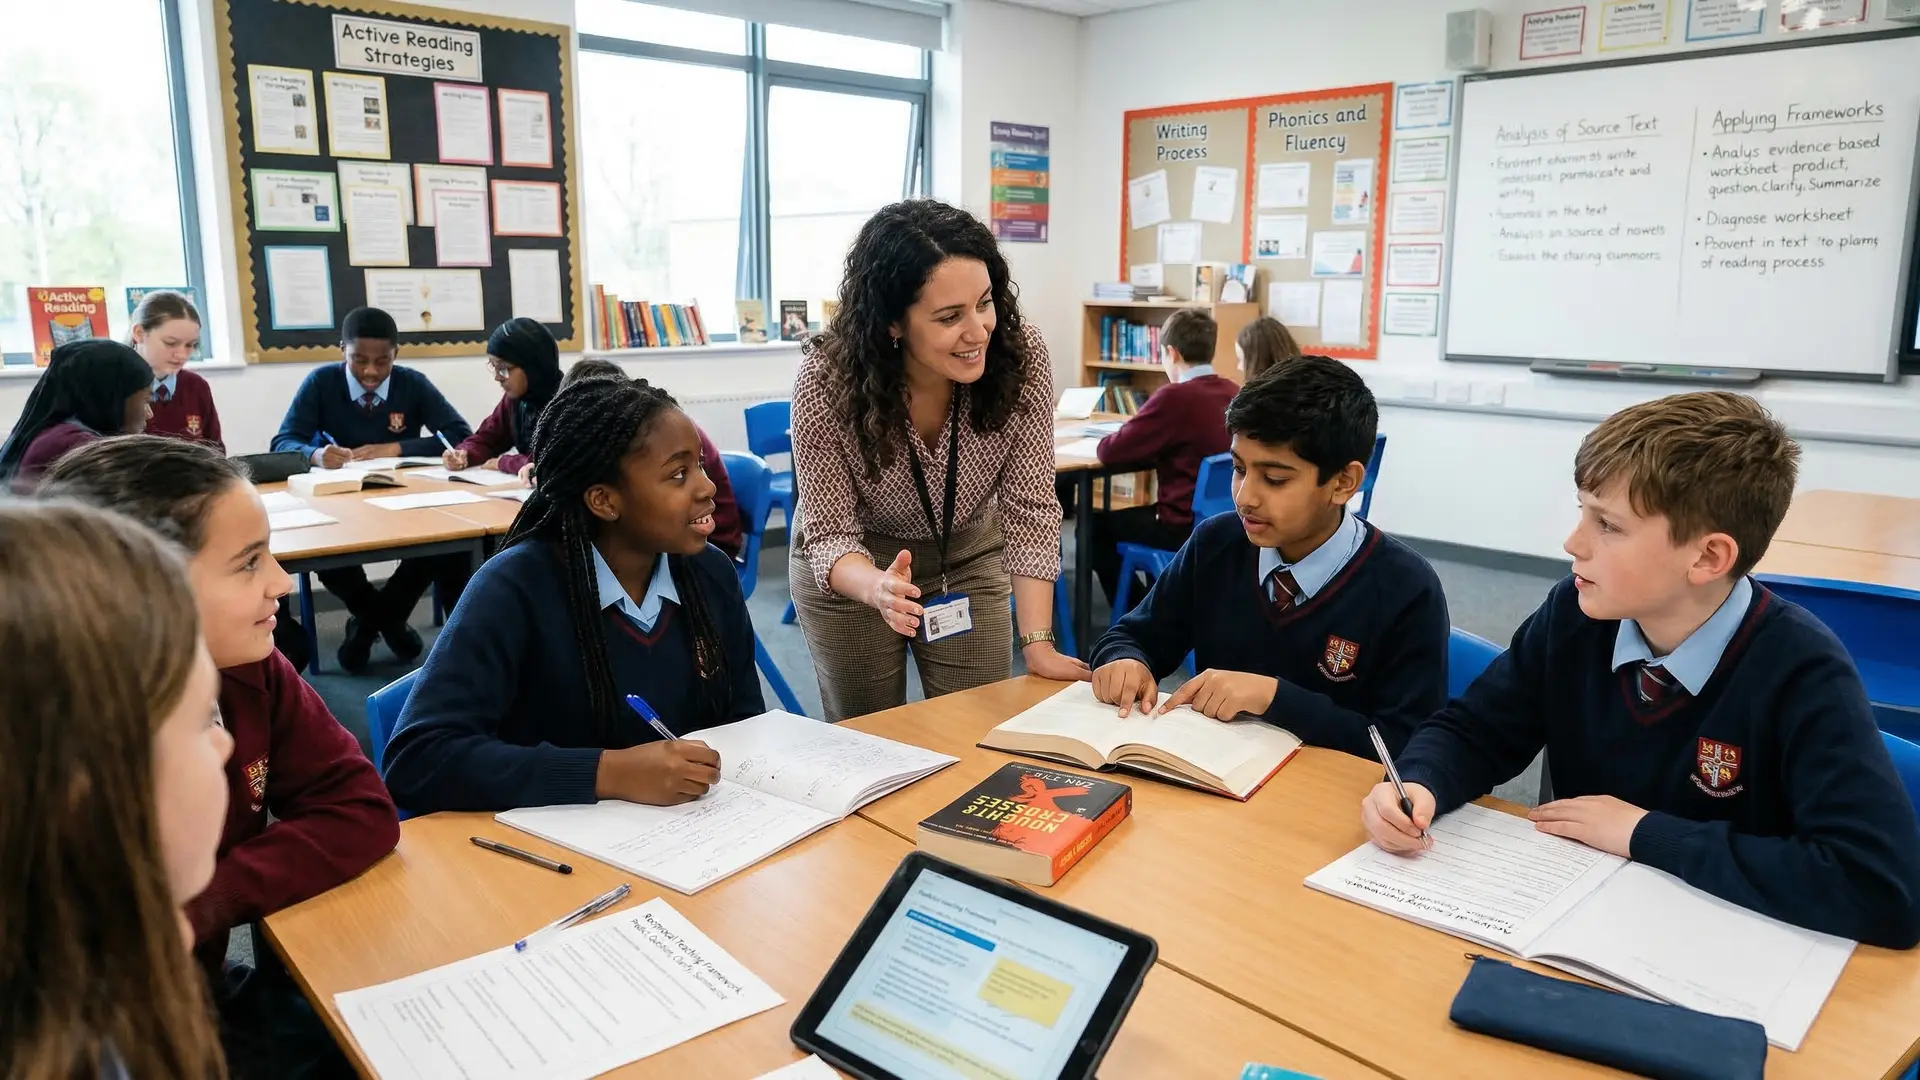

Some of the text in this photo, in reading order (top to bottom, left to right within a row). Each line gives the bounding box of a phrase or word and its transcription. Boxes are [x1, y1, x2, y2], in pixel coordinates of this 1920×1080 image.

[342, 24, 473, 57] Active Reading
[364, 47, 454, 72] Strategies
[1268, 103, 1367, 129] Phonics and
[1711, 100, 1884, 133] Applying Frameworks
[1156, 124, 1208, 141] Writing
[1496, 113, 1659, 145] Analysis of Source Text
[1285, 134, 1346, 153] Fluency
[1711, 144, 1760, 162] Analys
[1156, 146, 1207, 161] Process
[1710, 161, 1778, 178] worksheet
[1808, 176, 1881, 191] Summarize
[1706, 206, 1853, 231] Diagnose worksheet
[1762, 236, 1775, 248] in
[1781, 235, 1808, 248] text
[1701, 255, 1825, 275] of reading process
[48, 291, 87, 303] Active
[44, 302, 97, 314] Reading
[973, 795, 1070, 823] CROSSES
